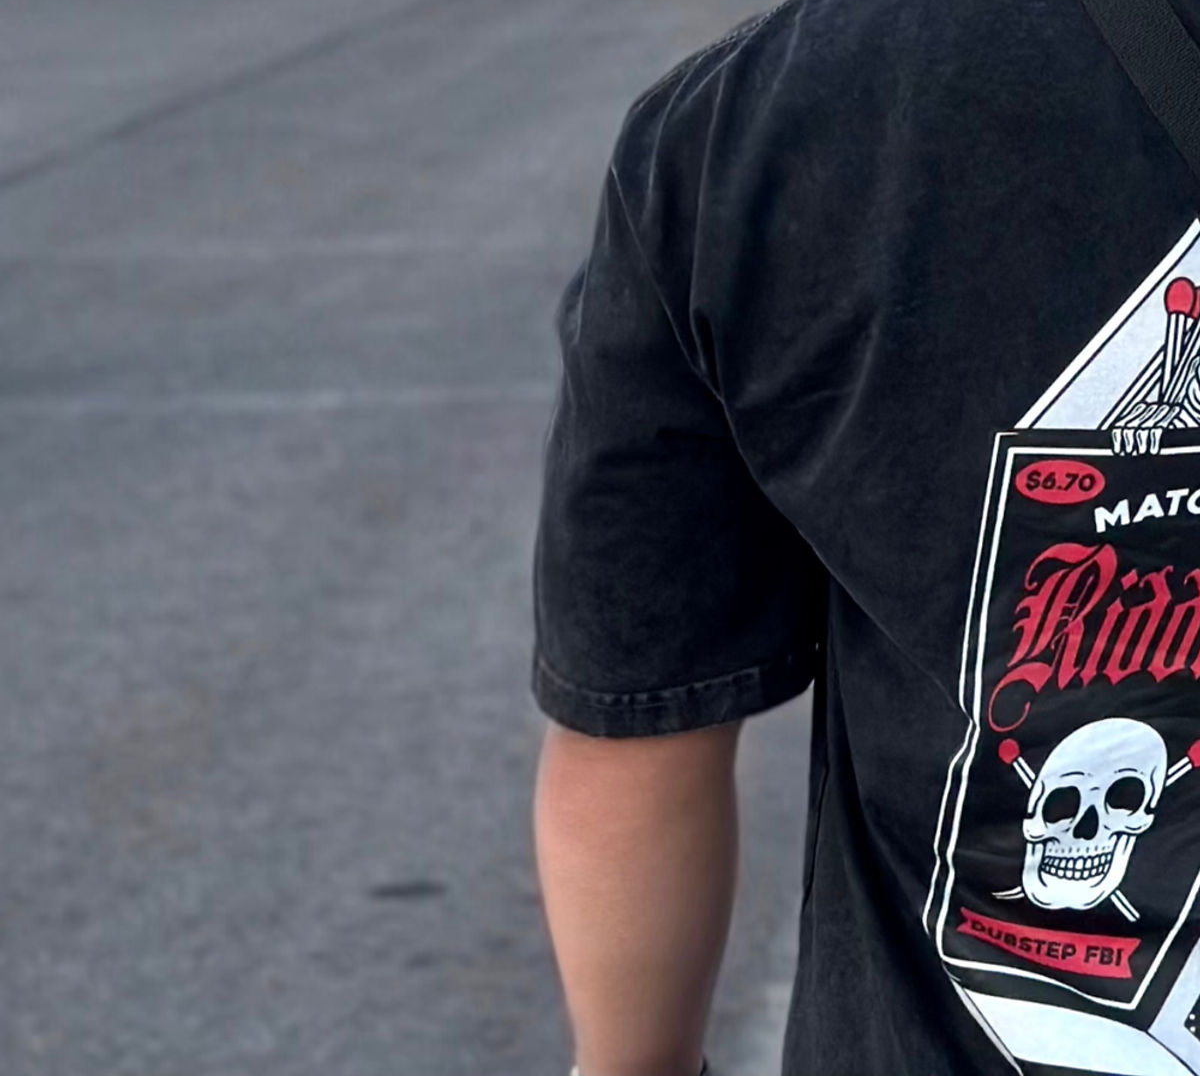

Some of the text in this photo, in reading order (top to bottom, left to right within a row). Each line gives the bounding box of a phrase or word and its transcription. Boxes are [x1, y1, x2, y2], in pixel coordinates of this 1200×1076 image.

[1024, 470, 1096, 492] $6.70
[970, 920, 1125, 967] DUBSTEP FBI
